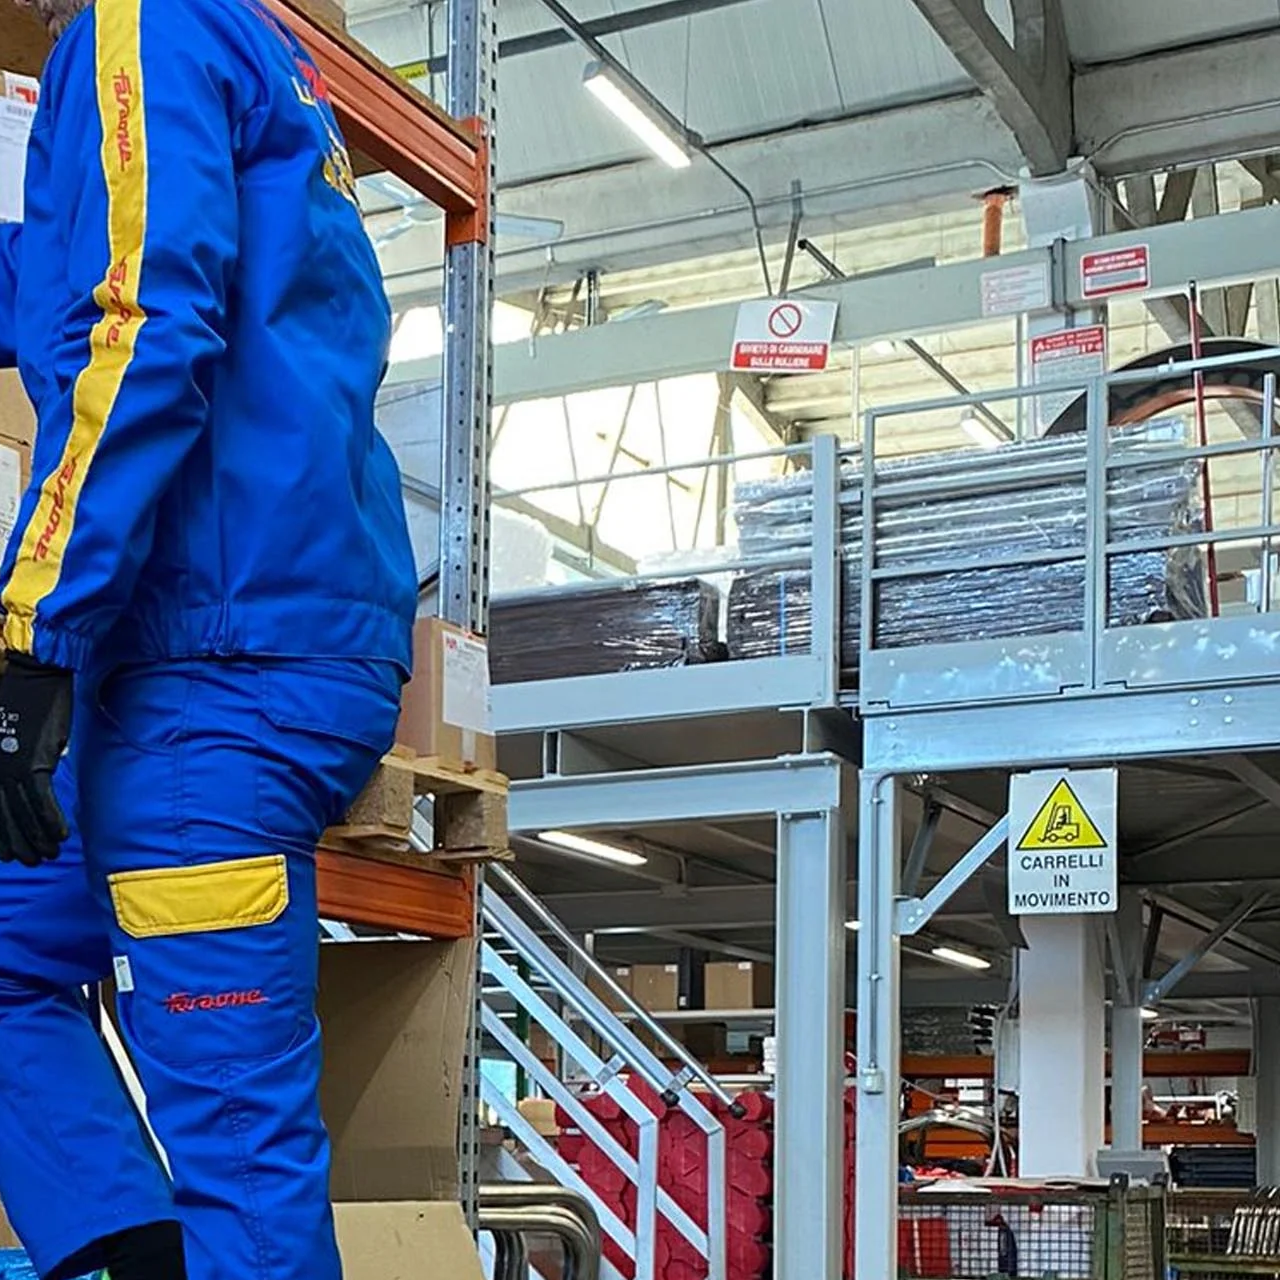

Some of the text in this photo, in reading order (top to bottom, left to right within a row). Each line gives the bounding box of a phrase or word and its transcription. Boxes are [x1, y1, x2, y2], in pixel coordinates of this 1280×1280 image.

[1021, 855, 1103, 871] CARRELLI
[1054, 874, 1070, 887] IN
[1015, 891, 1111, 907] MOVIMENTO
